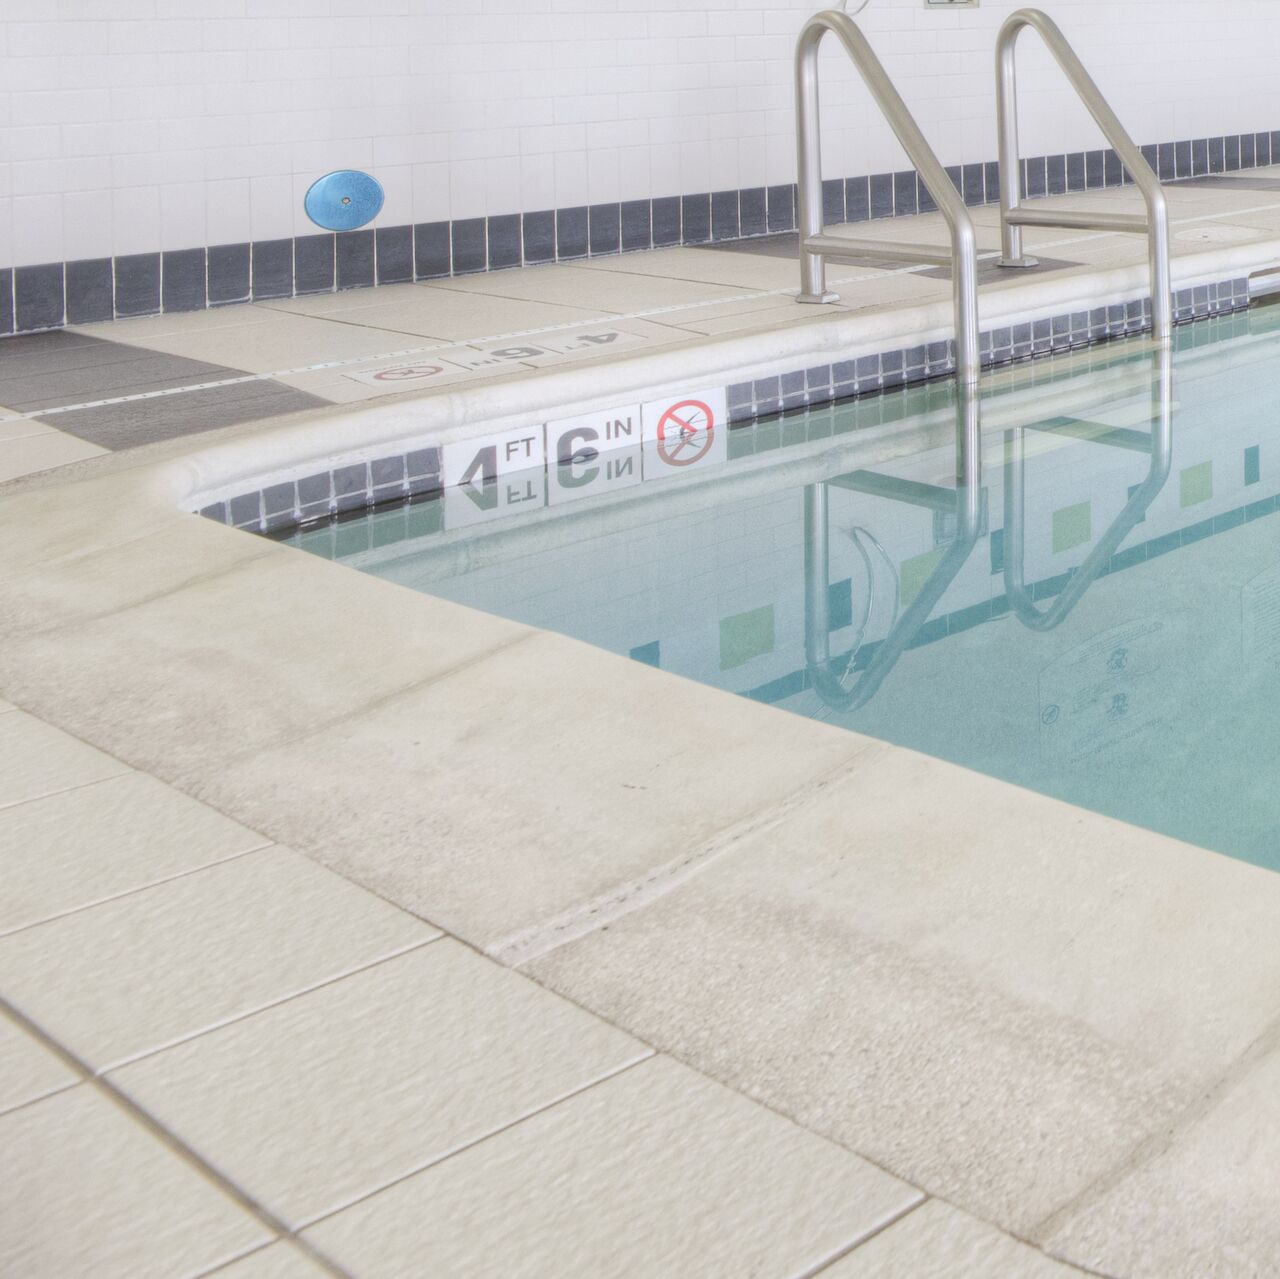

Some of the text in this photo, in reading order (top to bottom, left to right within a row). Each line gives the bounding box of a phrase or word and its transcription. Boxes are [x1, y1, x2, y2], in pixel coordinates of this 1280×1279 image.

[576, 331, 619, 345] 4
[506, 436, 536, 462] FT
[556, 426, 600, 466] 6
[605, 417, 632, 441] IN
